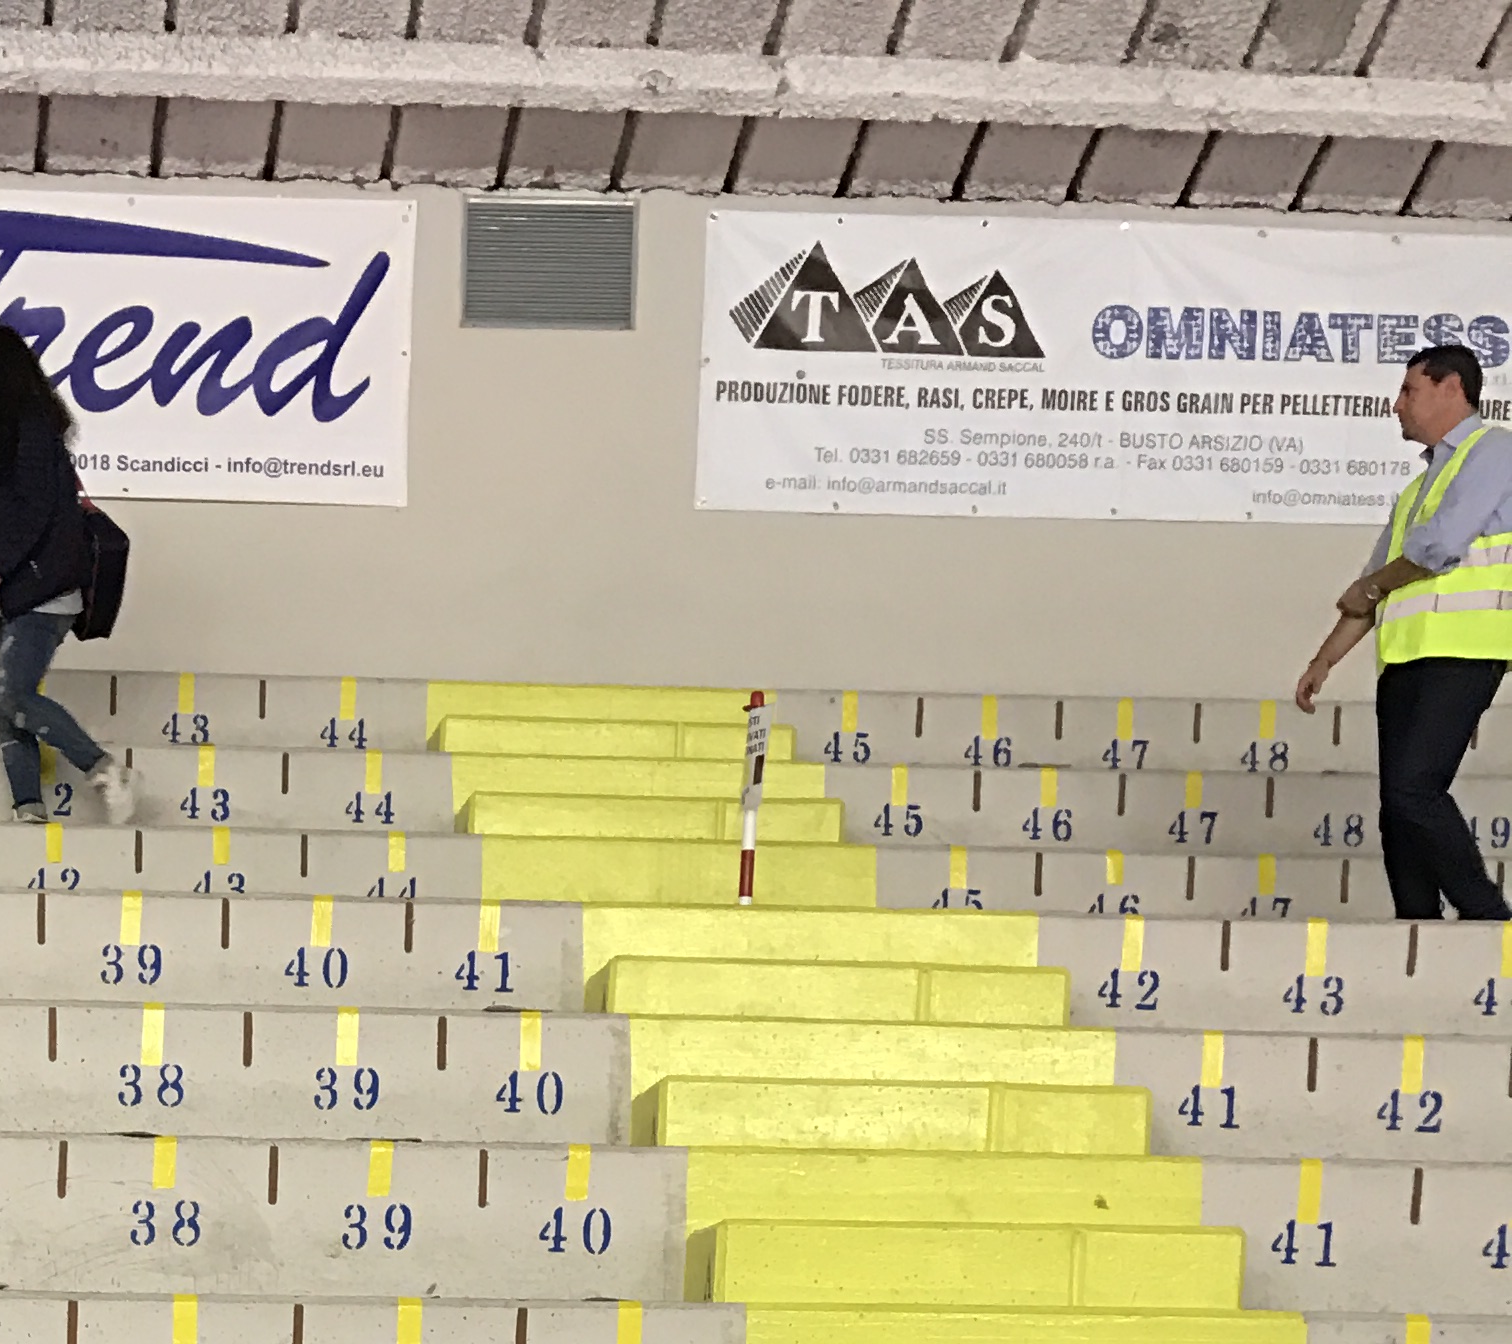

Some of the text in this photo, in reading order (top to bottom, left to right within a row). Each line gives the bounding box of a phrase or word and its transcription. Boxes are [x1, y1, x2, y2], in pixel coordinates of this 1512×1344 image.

[1092, 305, 1511, 369] OMNIATESS
[881, 358, 1046, 373] TESSITURA ARMAND SACCAL
[715, 380, 1393, 419] PRODUZIONE FODERE, RASI, CREPE, MOIRE E GROS GRAIN PER PELLETTERIA
[815, 446, 843, 464] Tel.
[849, 449, 889, 465] 0331
[896, 450, 962, 467] 682659
[977, 451, 1017, 468] 0331
[1024, 452, 1088, 470] 680058
[1137, 454, 1168, 472] Fax
[1172, 455, 1213, 472] 0331
[1220, 457, 1285, 474] 680159
[1299, 459, 1340, 475] 0331
[1346, 460, 1411, 476] 680178
[924, 428, 1305, 456] SS. Sempione, 240/t BUSTO ARSIZIO (VA)
[116, 455, 210, 474] Scandicci
[226, 457, 385, 480] info@trendsrl.eu
[765, 475, 1399, 507] e-mail: info@armandsaccal.it info@omniatess.i
[163, 711, 211, 746] 43
[823, 730, 872, 766] 45
[1103, 738, 1149, 770] 47
[179, 786, 231, 823] 43
[873, 803, 924, 837] 45
[1168, 810, 1218, 845] 47
[100, 943, 162, 986] 39
[454, 949, 514, 994] 41
[1282, 974, 1345, 1017] 43
[313, 1066, 380, 1111] 39
[1177, 1084, 1240, 1130] 41
[341, 1202, 413, 1251] 39
[1270, 1218, 1336, 1268] 41
